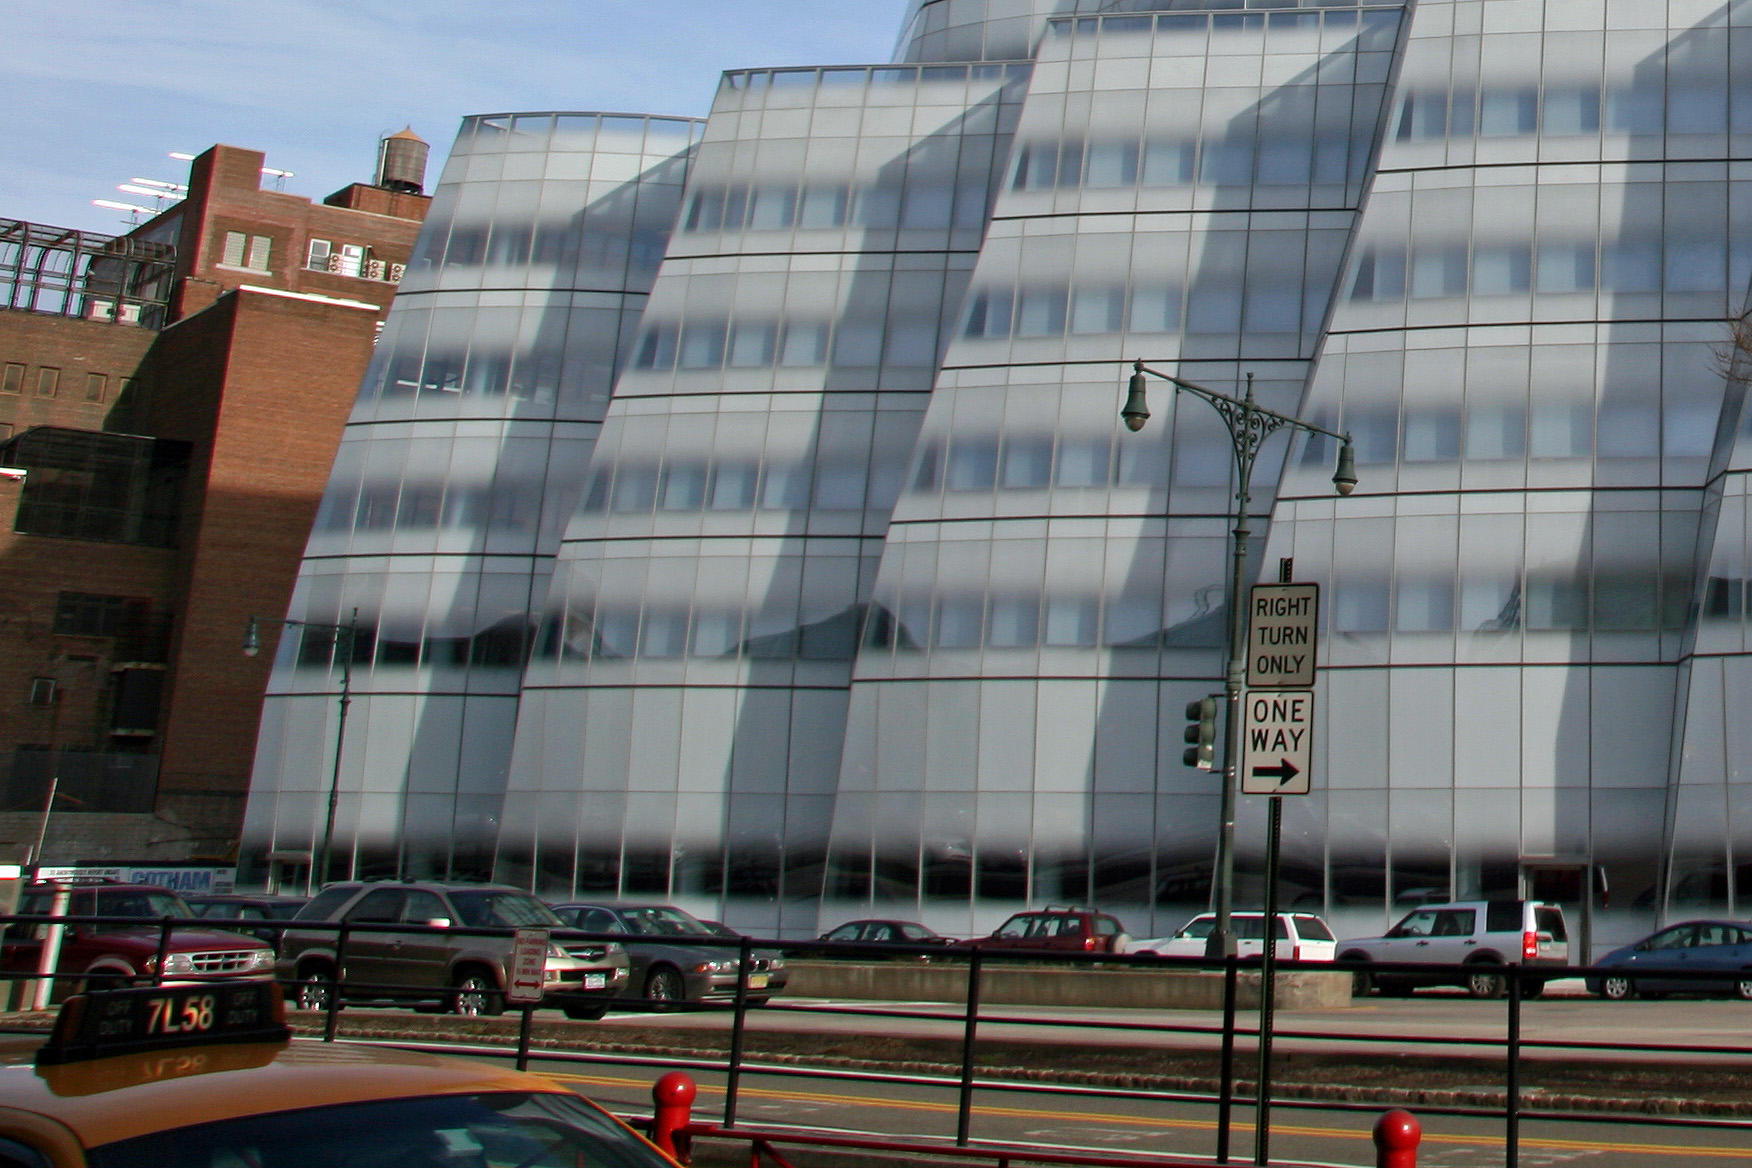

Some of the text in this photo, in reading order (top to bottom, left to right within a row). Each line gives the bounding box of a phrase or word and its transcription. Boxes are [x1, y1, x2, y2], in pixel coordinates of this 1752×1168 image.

[1256, 597, 1312, 617] RIGHT
[1258, 626, 1308, 645] TURN
[1256, 655, 1306, 675] ONLY
[1253, 699, 1305, 723] ONE
[1251, 728, 1305, 753] WAY
[148, 995, 216, 1034] 7L58
